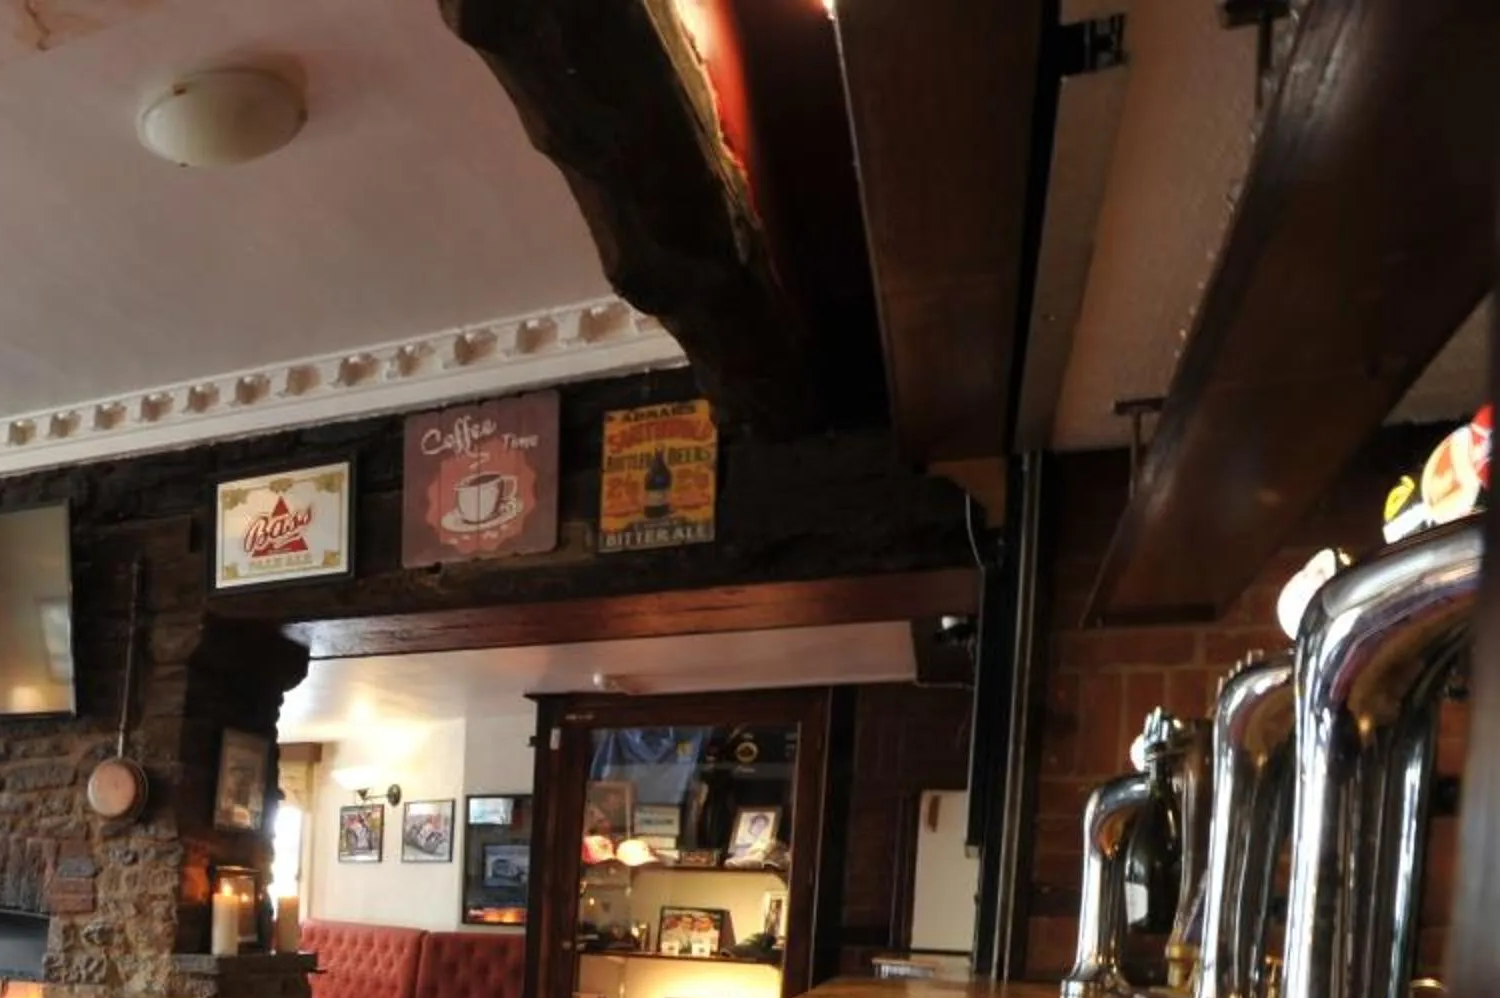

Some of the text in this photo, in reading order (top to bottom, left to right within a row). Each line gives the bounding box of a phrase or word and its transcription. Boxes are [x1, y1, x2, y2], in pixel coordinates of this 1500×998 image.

[421, 414, 497, 457] Coffee
[243, 504, 313, 553] Bass
[605, 524, 709, 547] BITTER ALE
